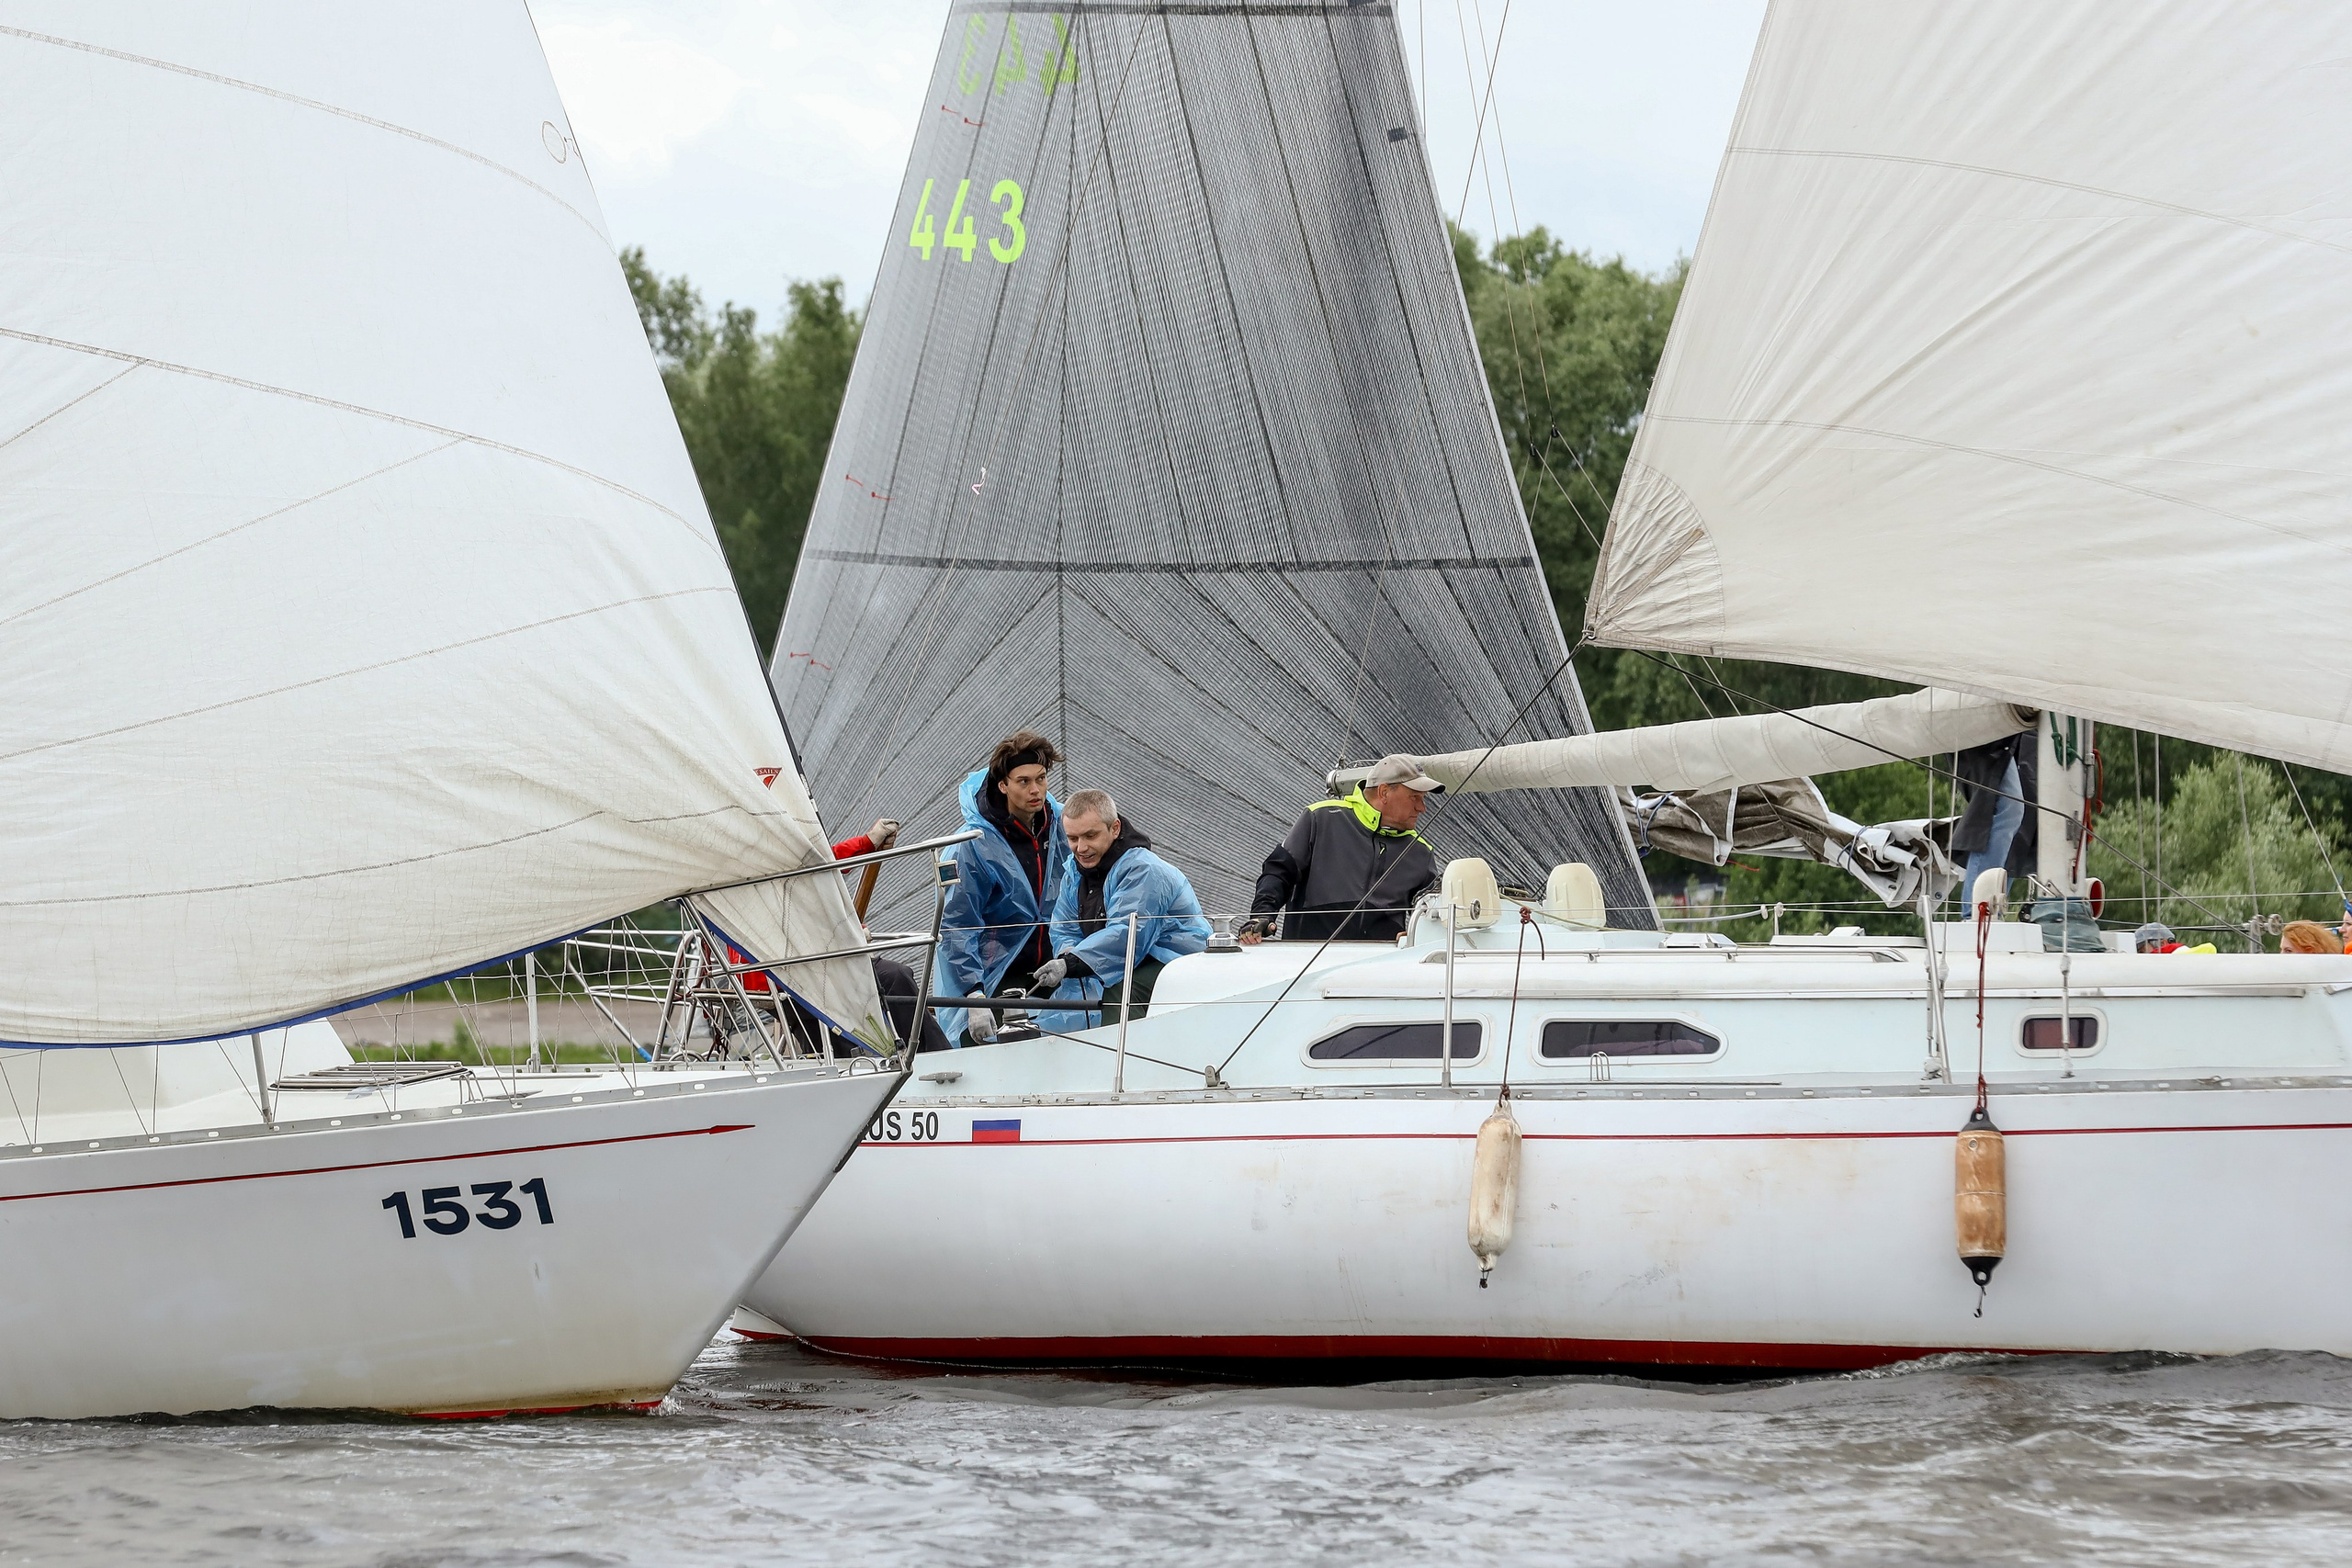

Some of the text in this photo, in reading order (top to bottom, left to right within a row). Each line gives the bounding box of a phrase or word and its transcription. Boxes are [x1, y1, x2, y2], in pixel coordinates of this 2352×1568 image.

[909, 178, 1026, 264] 443
[865, 1111, 939, 1141] US 50
[381, 1177, 555, 1239] 1531
